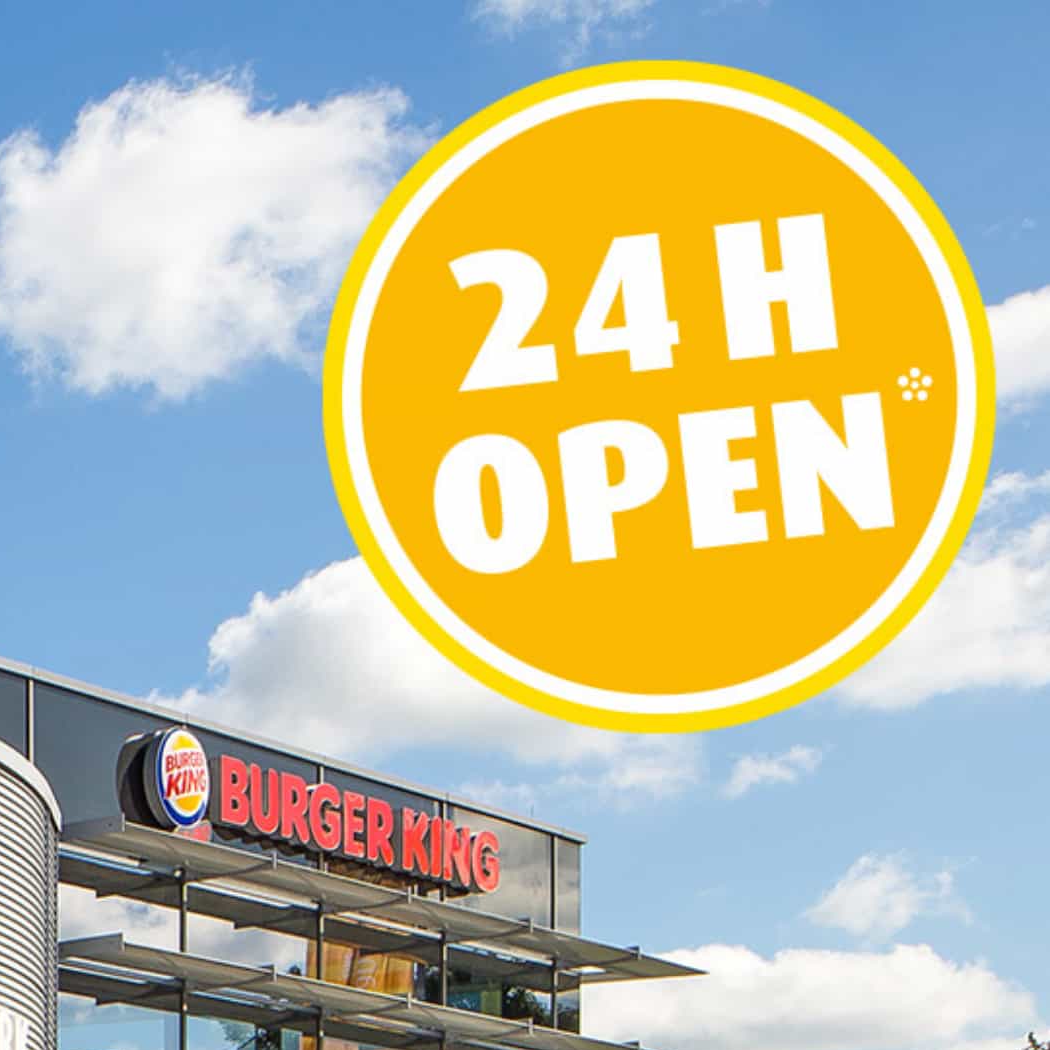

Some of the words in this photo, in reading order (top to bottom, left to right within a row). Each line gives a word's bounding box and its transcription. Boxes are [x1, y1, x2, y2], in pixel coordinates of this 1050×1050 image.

[166, 768, 206, 798] KING
[221, 755, 394, 866] BURGER
[402, 807, 500, 893] KING
